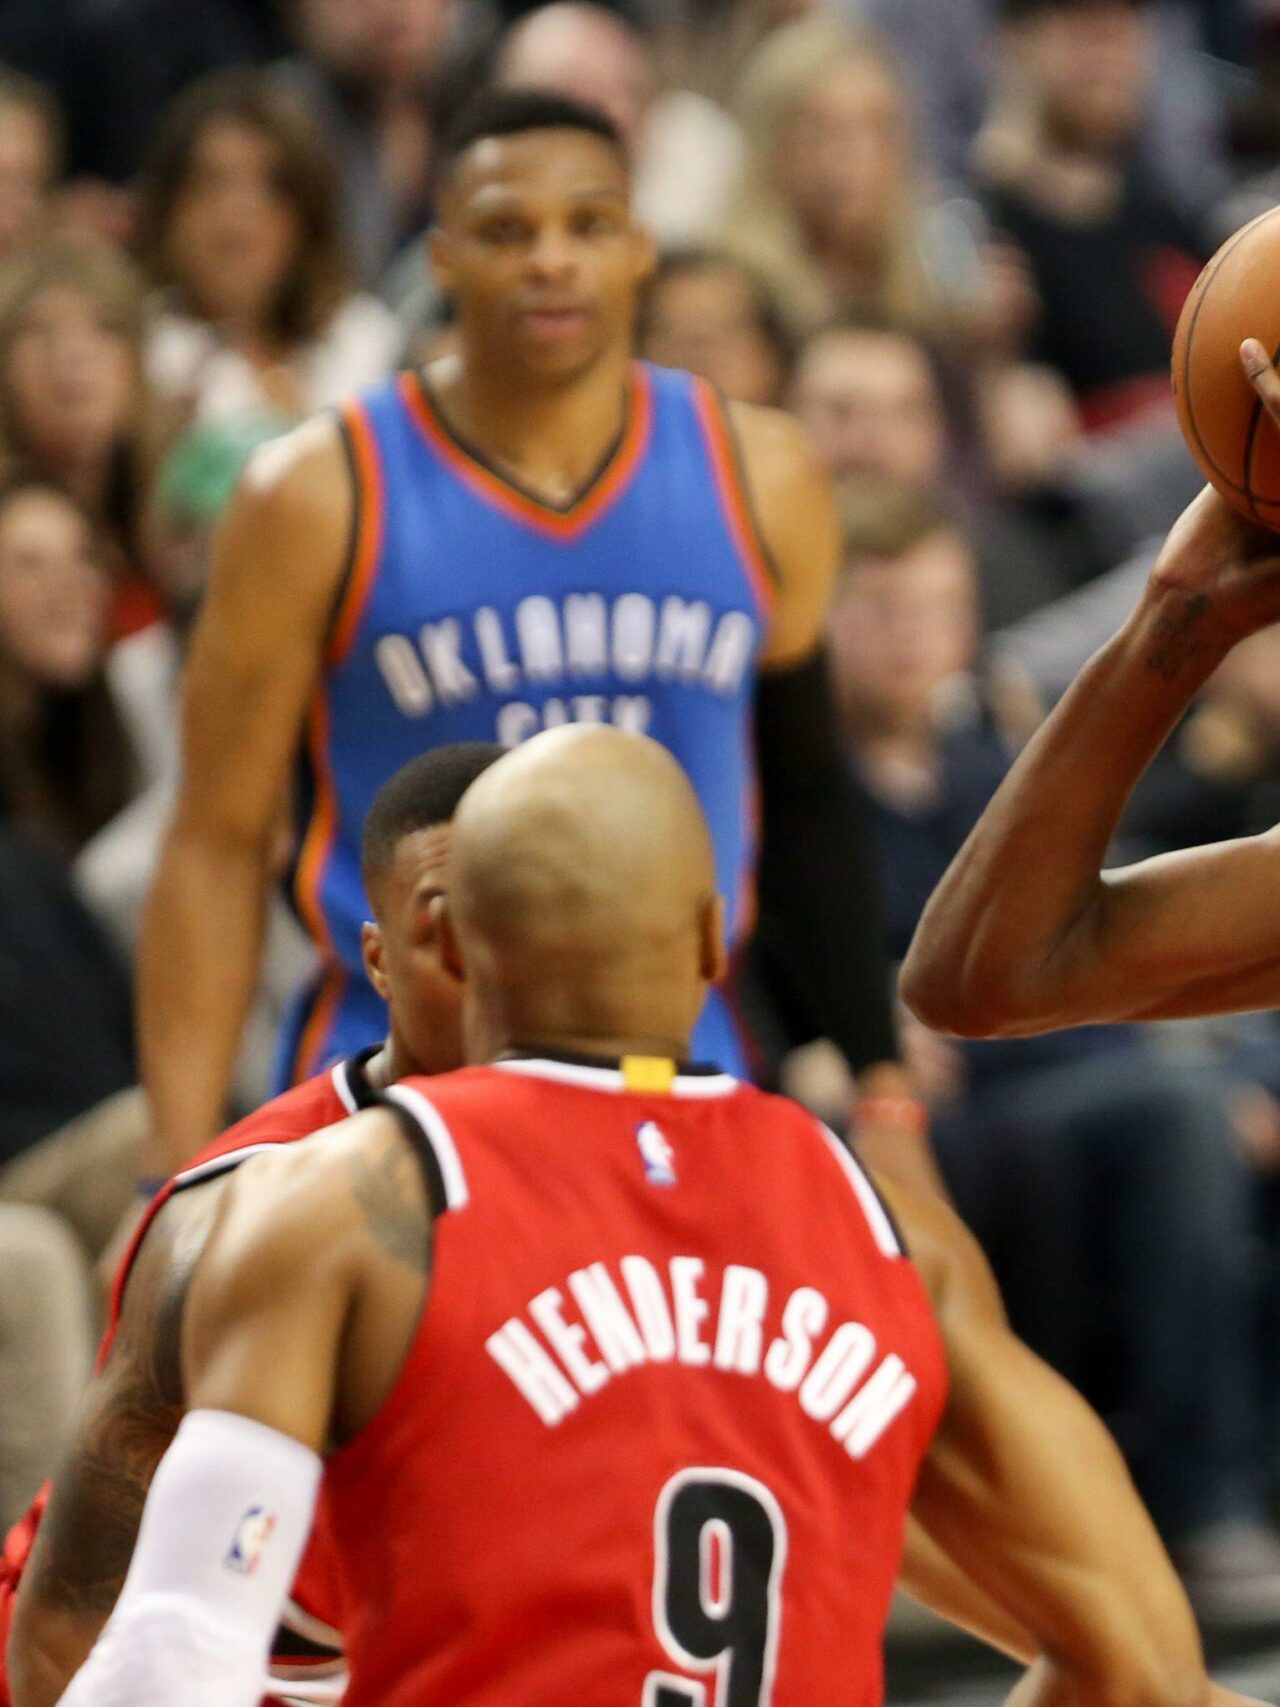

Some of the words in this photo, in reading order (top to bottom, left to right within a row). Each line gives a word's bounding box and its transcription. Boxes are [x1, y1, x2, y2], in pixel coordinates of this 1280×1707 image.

[374, 592, 754, 718] OKLAHOMA
[484, 1254, 917, 1460] HENDERSON
[641, 1466, 789, 1707] 9
